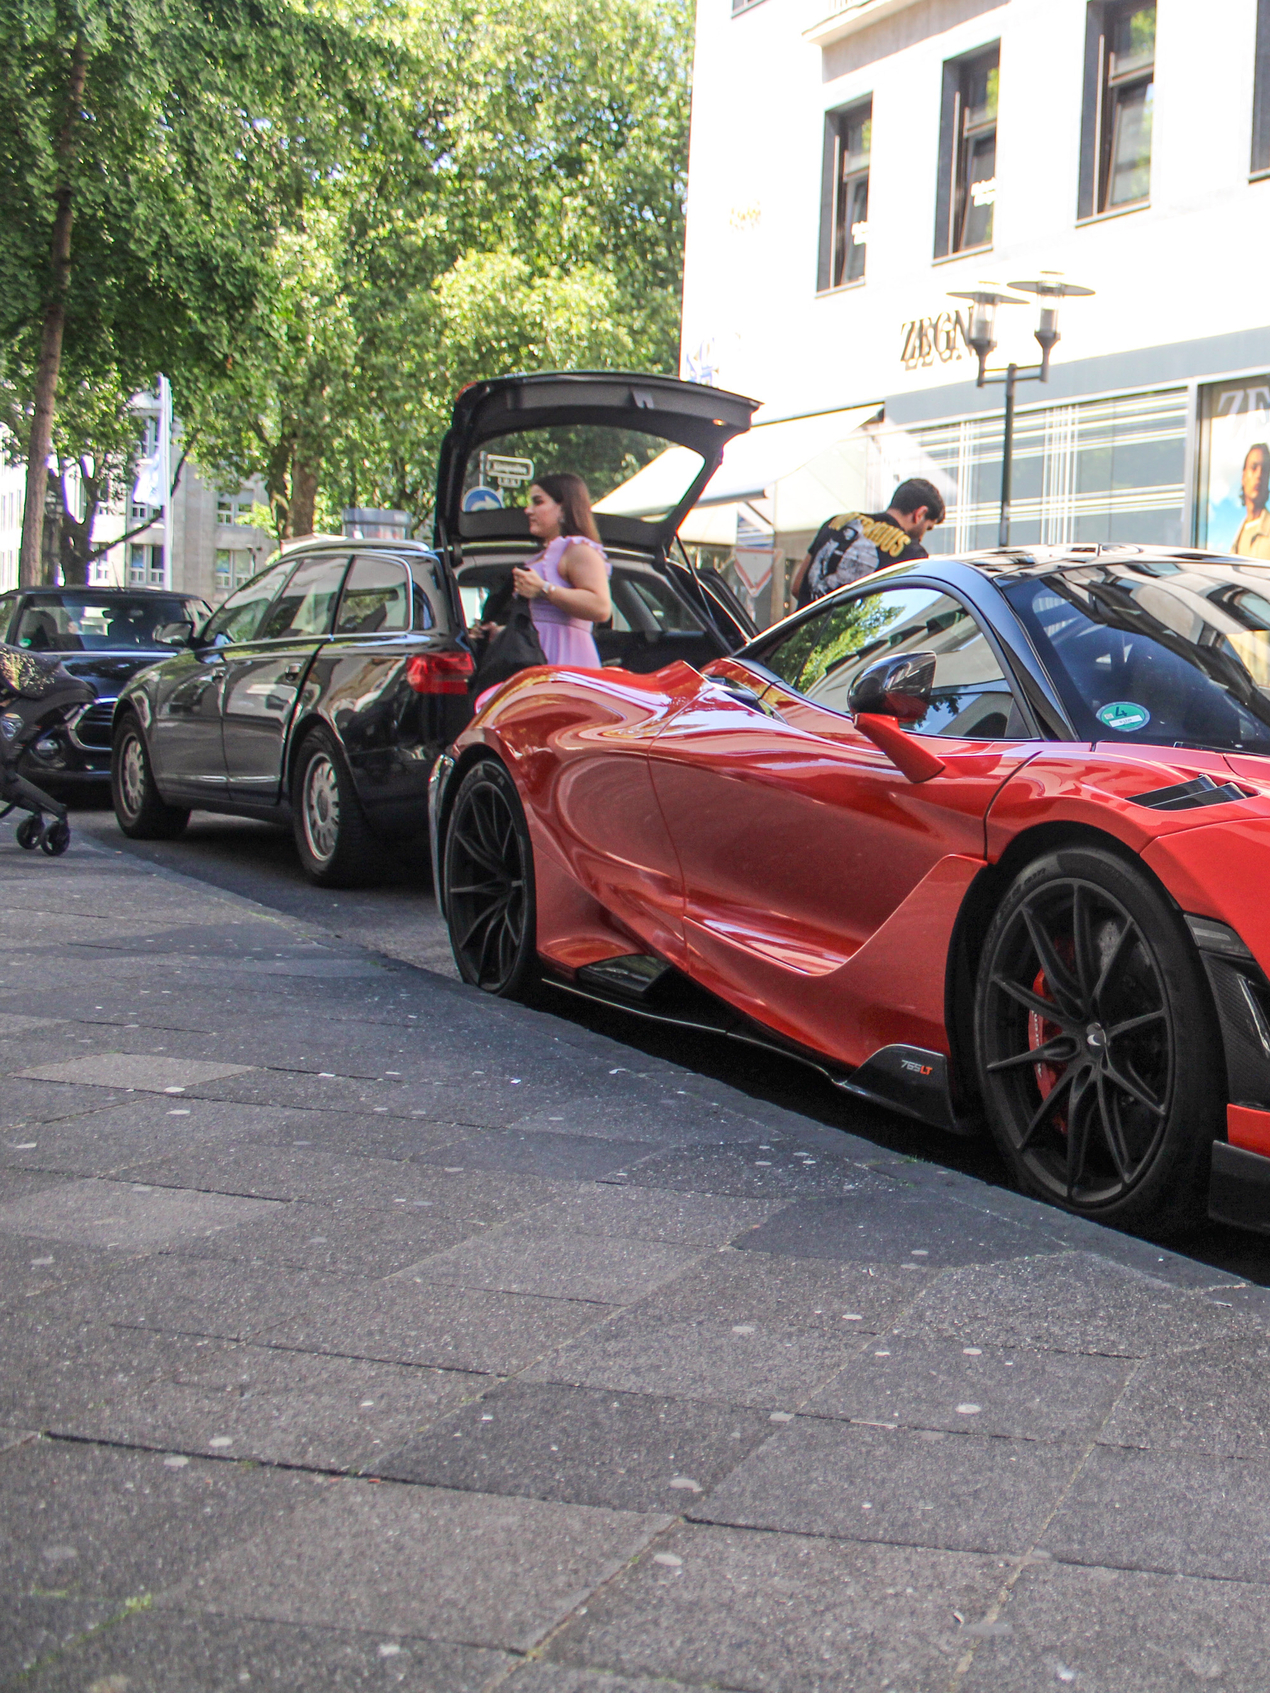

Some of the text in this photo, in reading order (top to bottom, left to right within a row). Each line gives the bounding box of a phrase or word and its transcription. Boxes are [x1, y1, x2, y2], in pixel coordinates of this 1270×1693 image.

[900, 305, 976, 363] ZEGN
[1115, 706, 1127, 717] 4
[901, 1060, 933, 1076] 765LT
